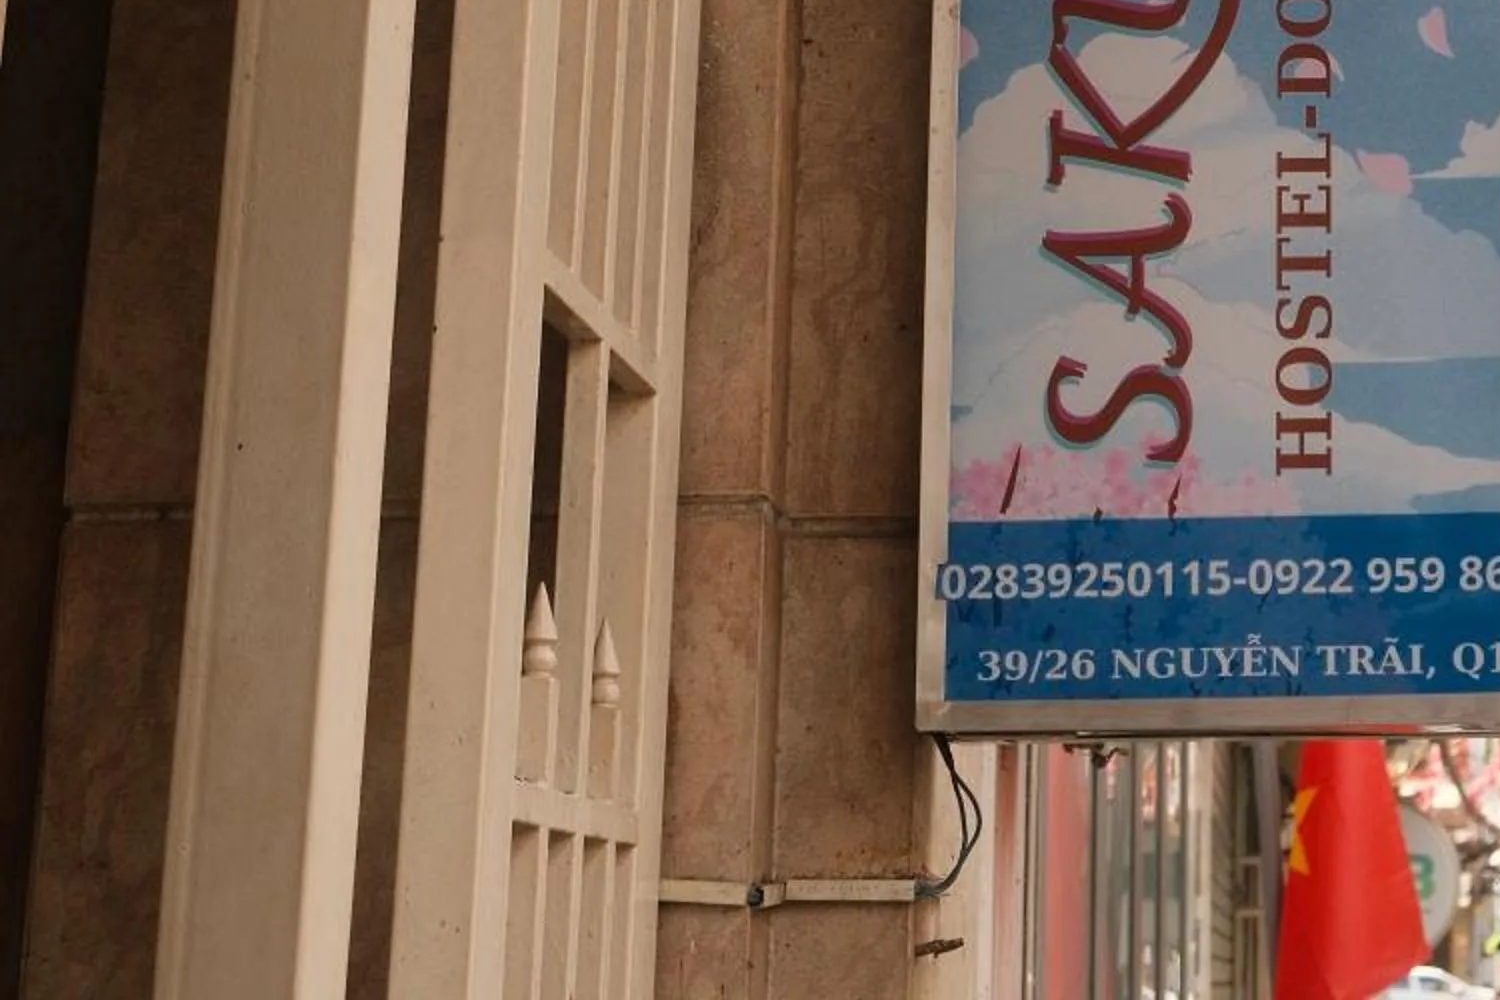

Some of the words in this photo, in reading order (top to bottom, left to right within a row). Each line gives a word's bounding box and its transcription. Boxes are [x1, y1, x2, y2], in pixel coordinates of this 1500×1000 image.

[941, 559, 1353, 600] 02839250115-0922
[1368, 557, 1445, 592] 959
[976, 649, 1096, 683] 39/26
[1111, 633, 1302, 680] NGUYỄN
[1315, 637, 1436, 680] TRÃI,
